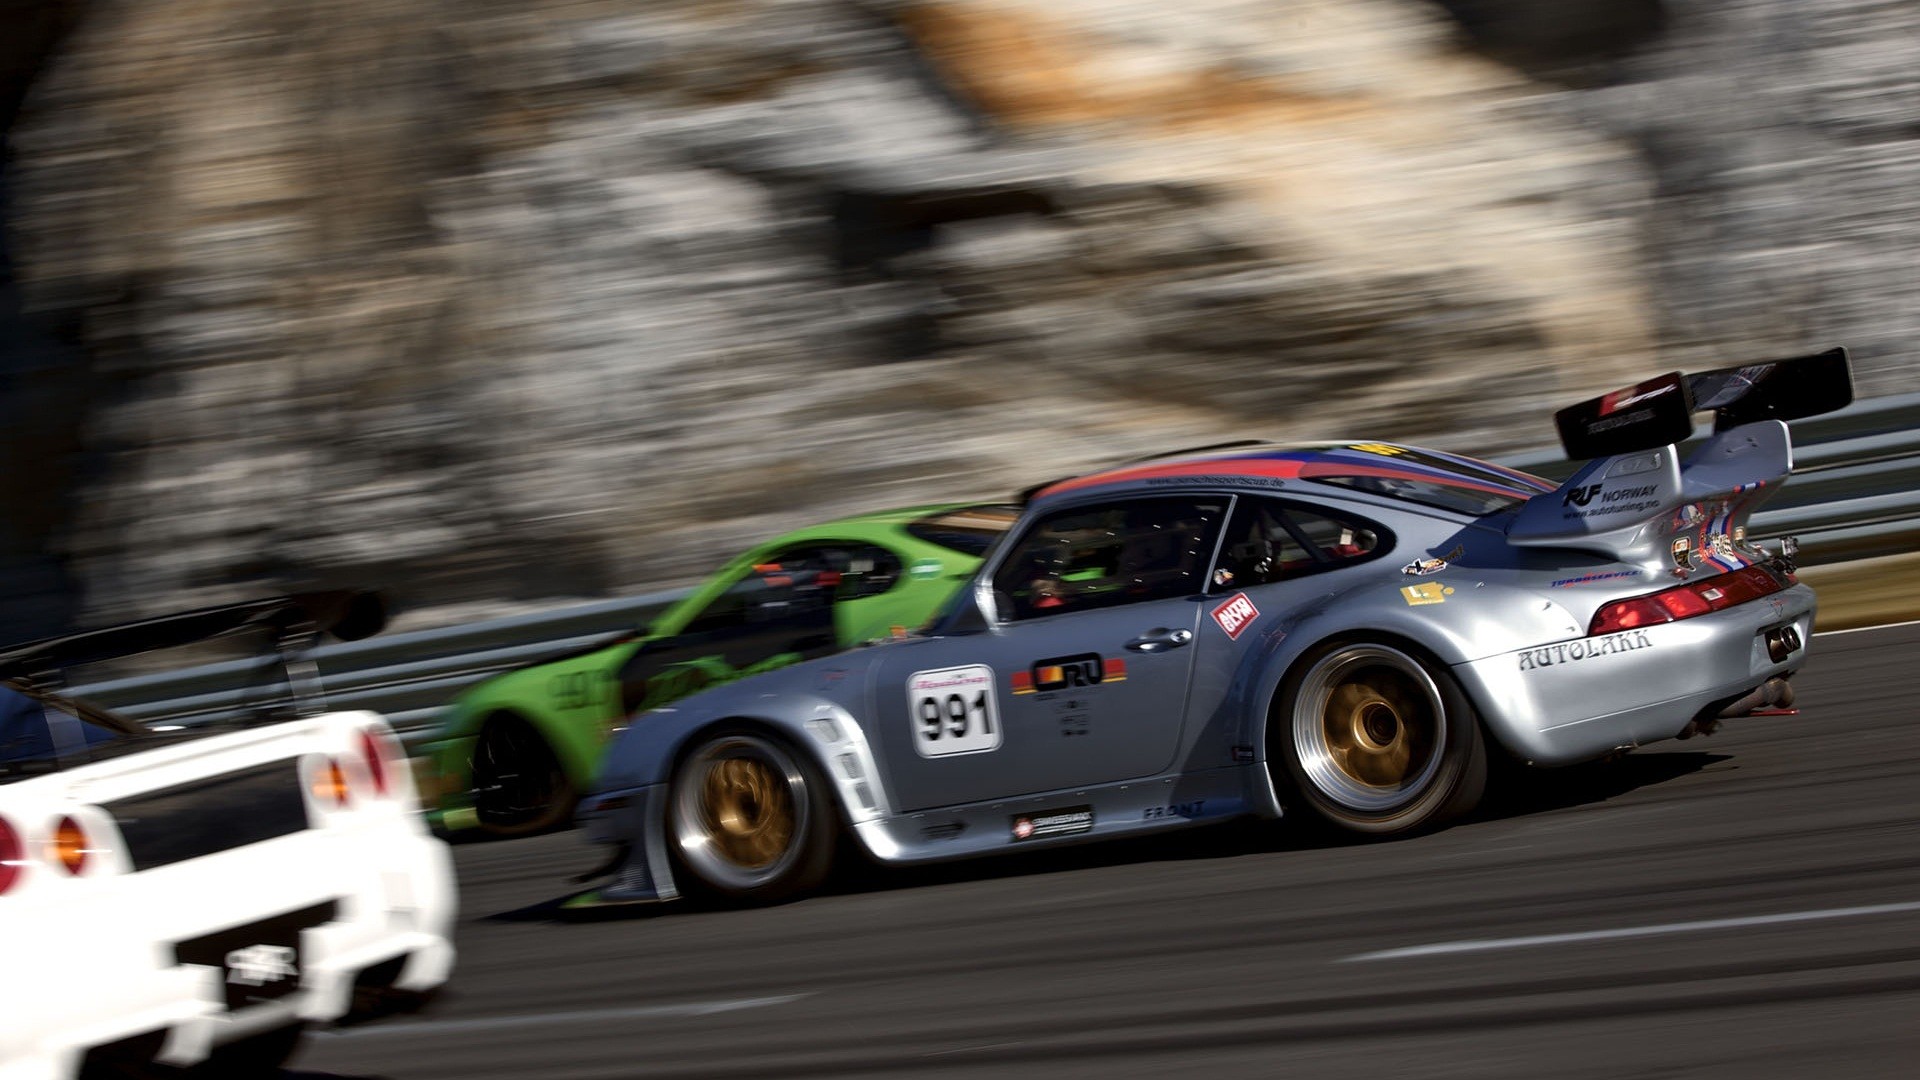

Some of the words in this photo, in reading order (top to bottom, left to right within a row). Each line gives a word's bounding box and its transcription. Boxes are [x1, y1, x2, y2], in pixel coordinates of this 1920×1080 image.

[1562, 483, 1603, 508] RUF
[1601, 484, 1659, 503] NORWAY
[1518, 629, 1653, 671] AUTOLAKK
[917, 689, 994, 741] 991
[1144, 800, 1206, 819] FRONT
